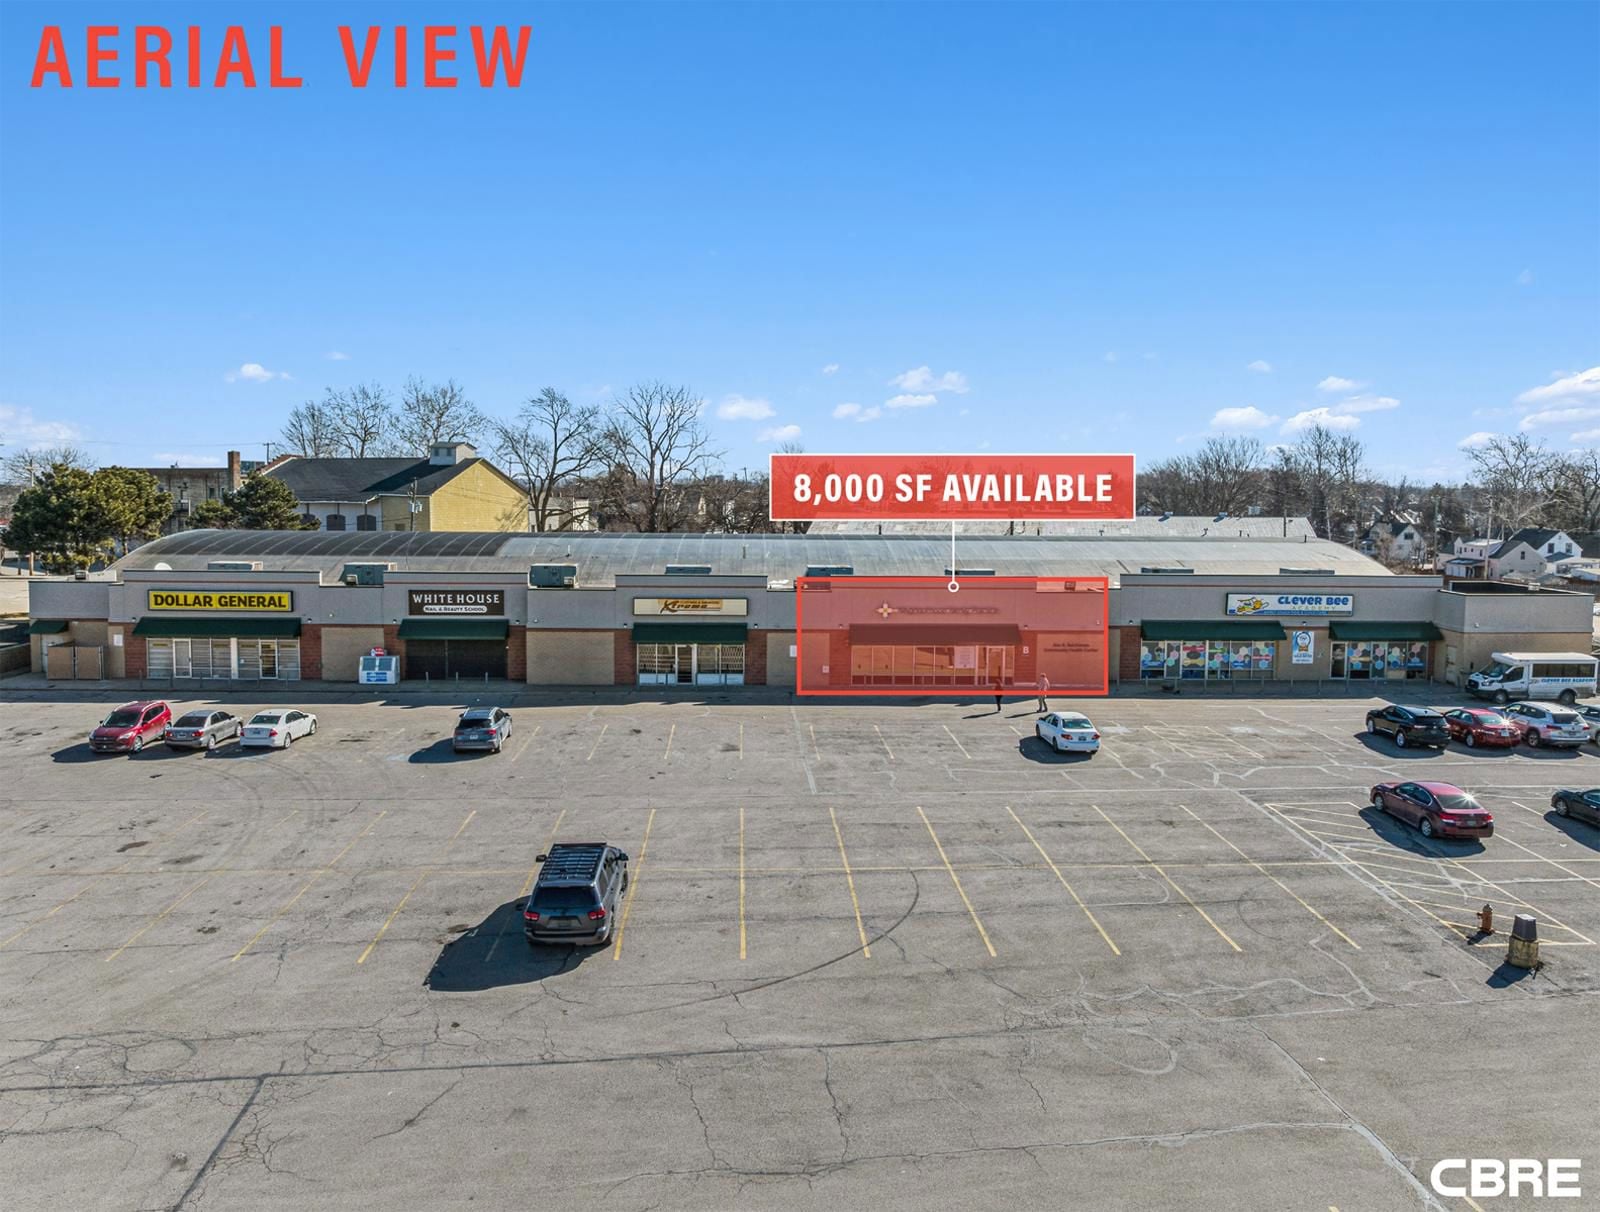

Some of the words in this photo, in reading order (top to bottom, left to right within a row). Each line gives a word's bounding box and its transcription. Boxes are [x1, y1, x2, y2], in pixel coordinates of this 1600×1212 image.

[153, 594, 213, 607] DOLLAR
[218, 595, 286, 608] GENERAL
[412, 594, 453, 604] WHITE
[457, 594, 500, 604] HOUSE
